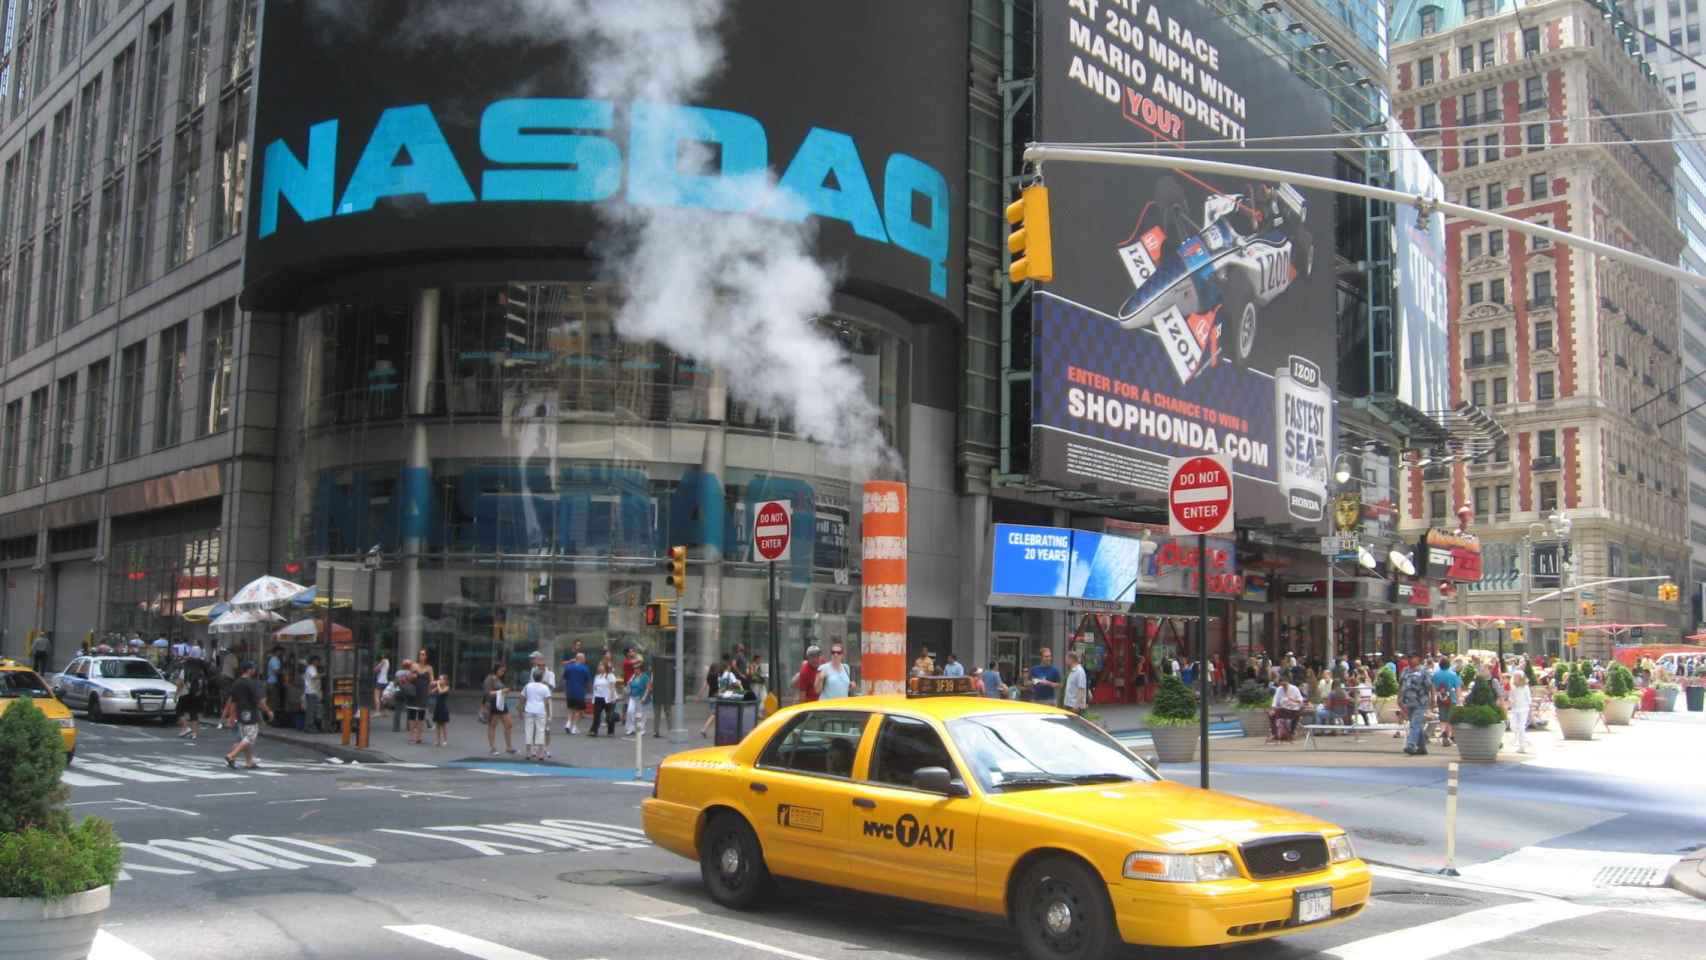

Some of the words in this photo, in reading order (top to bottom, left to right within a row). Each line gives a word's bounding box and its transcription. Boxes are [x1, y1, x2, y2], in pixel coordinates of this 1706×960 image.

[1069, 17, 1147, 85] MARIO
[1145, 5, 1162, 32] A
[1168, 16, 1219, 71] RACE
[1105, 9, 1144, 51] 200
[1149, 35, 1194, 85] MPH
[1199, 69, 1246, 119] WITH
[1068, 55, 1121, 104] AND
[1126, 87, 1182, 139] YOU?
[258, 96, 950, 299] NASDAQ
[1255, 250, 1290, 293] IZOD
[1293, 362, 1317, 383] IZOD
[1067, 366, 1111, 391] ENTER
[1114, 380, 1140, 400] FOR
[1141, 388, 1151, 402] A
[1153, 392, 1201, 417] CHANCE
[1203, 408, 1217, 424] TO
[1219, 414, 1243, 430] WIN
[1284, 392, 1325, 438] FASTEST
[1067, 387, 1269, 467] SHOPHONDA.COM
[1284, 429, 1326, 468] SEAT
[1179, 473, 1196, 487] DO
[1199, 470, 1220, 485] NOT
[760, 513, 769, 523] DO
[770, 512, 783, 522] NOT
[1183, 504, 1219, 519] ENTER
[1291, 495, 1321, 511] HONDA
[761, 539, 782, 549] ENTER
[1008, 532, 1068, 548] CELEBRATING
[1024, 547, 1036, 560] 20
[1038, 548, 1067, 561] YEARS
[863, 820, 894, 840] NYC
[896, 813, 954, 851] TAXI
